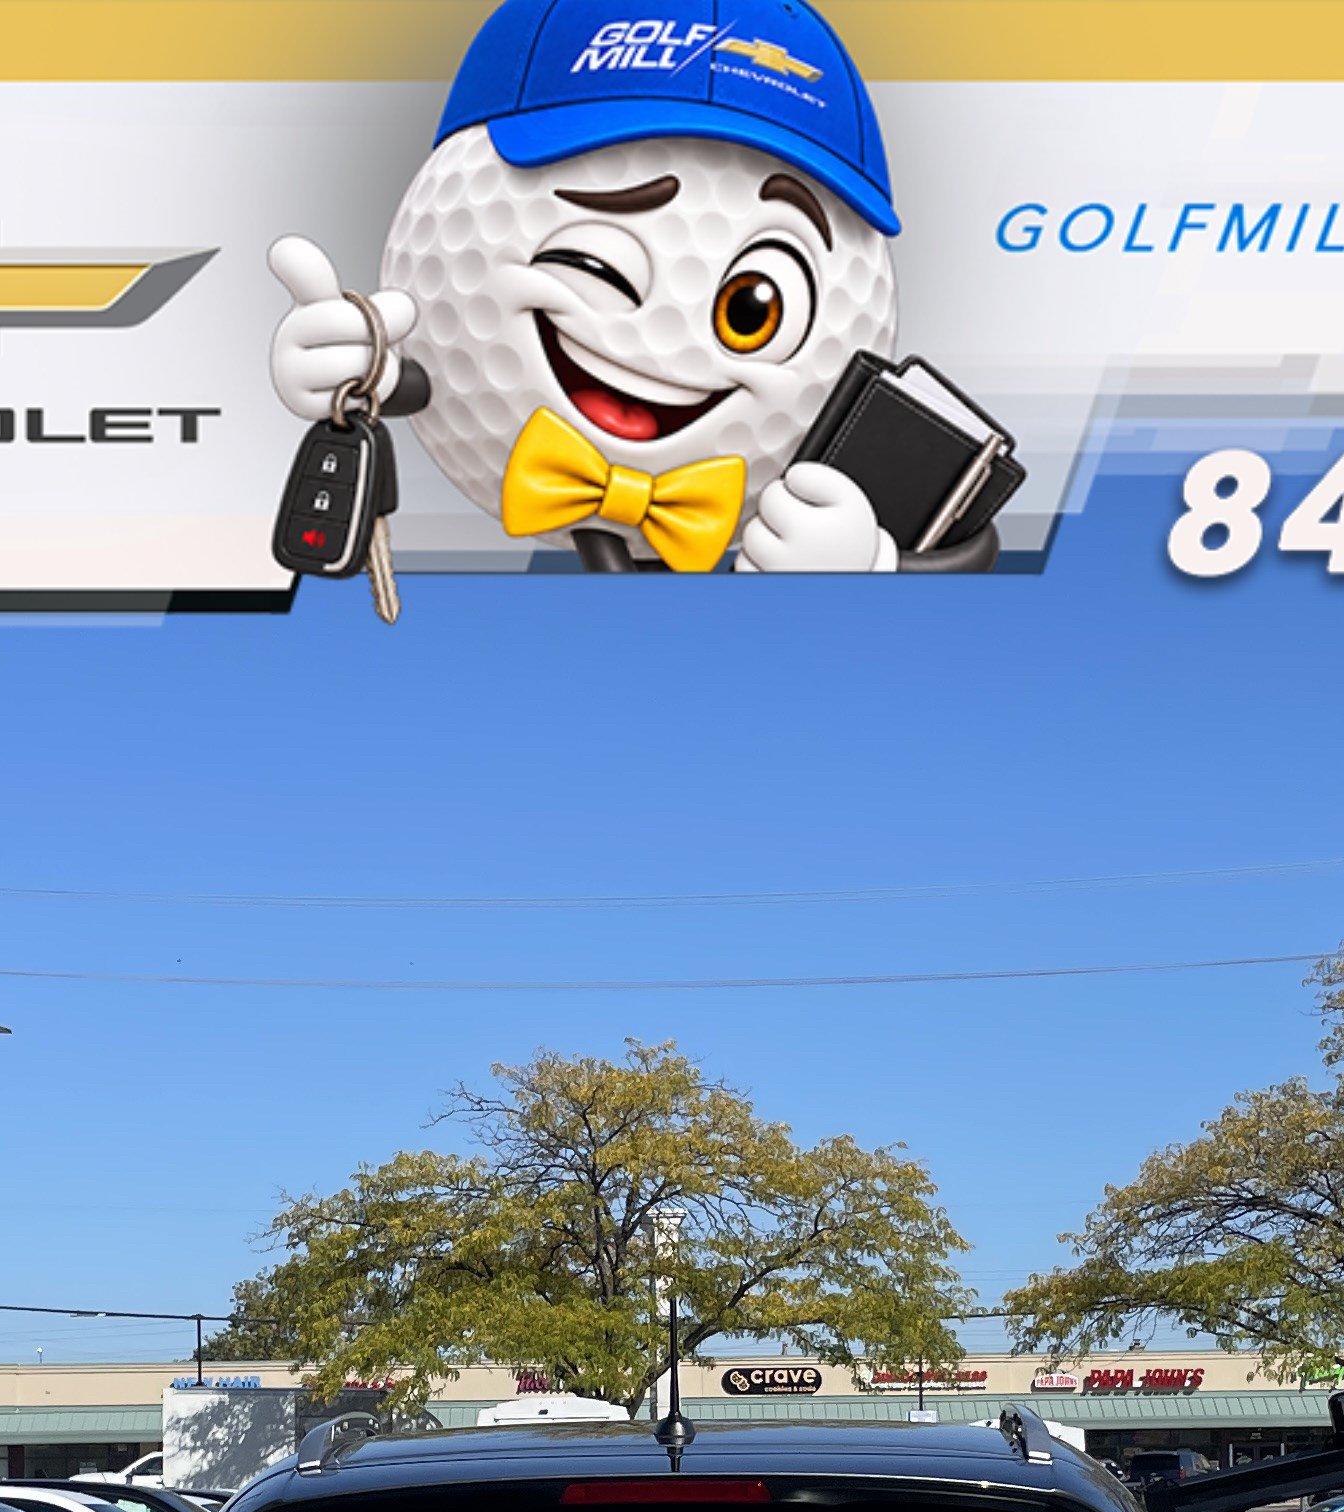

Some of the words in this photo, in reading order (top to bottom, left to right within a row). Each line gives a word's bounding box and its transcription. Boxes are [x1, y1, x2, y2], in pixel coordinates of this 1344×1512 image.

[218, 1376, 261, 1388] HAIR
[750, 1369, 817, 1384] crave
[1088, 1368, 1134, 1389] PAPA
[1141, 1368, 1205, 1389] JOHN'S
